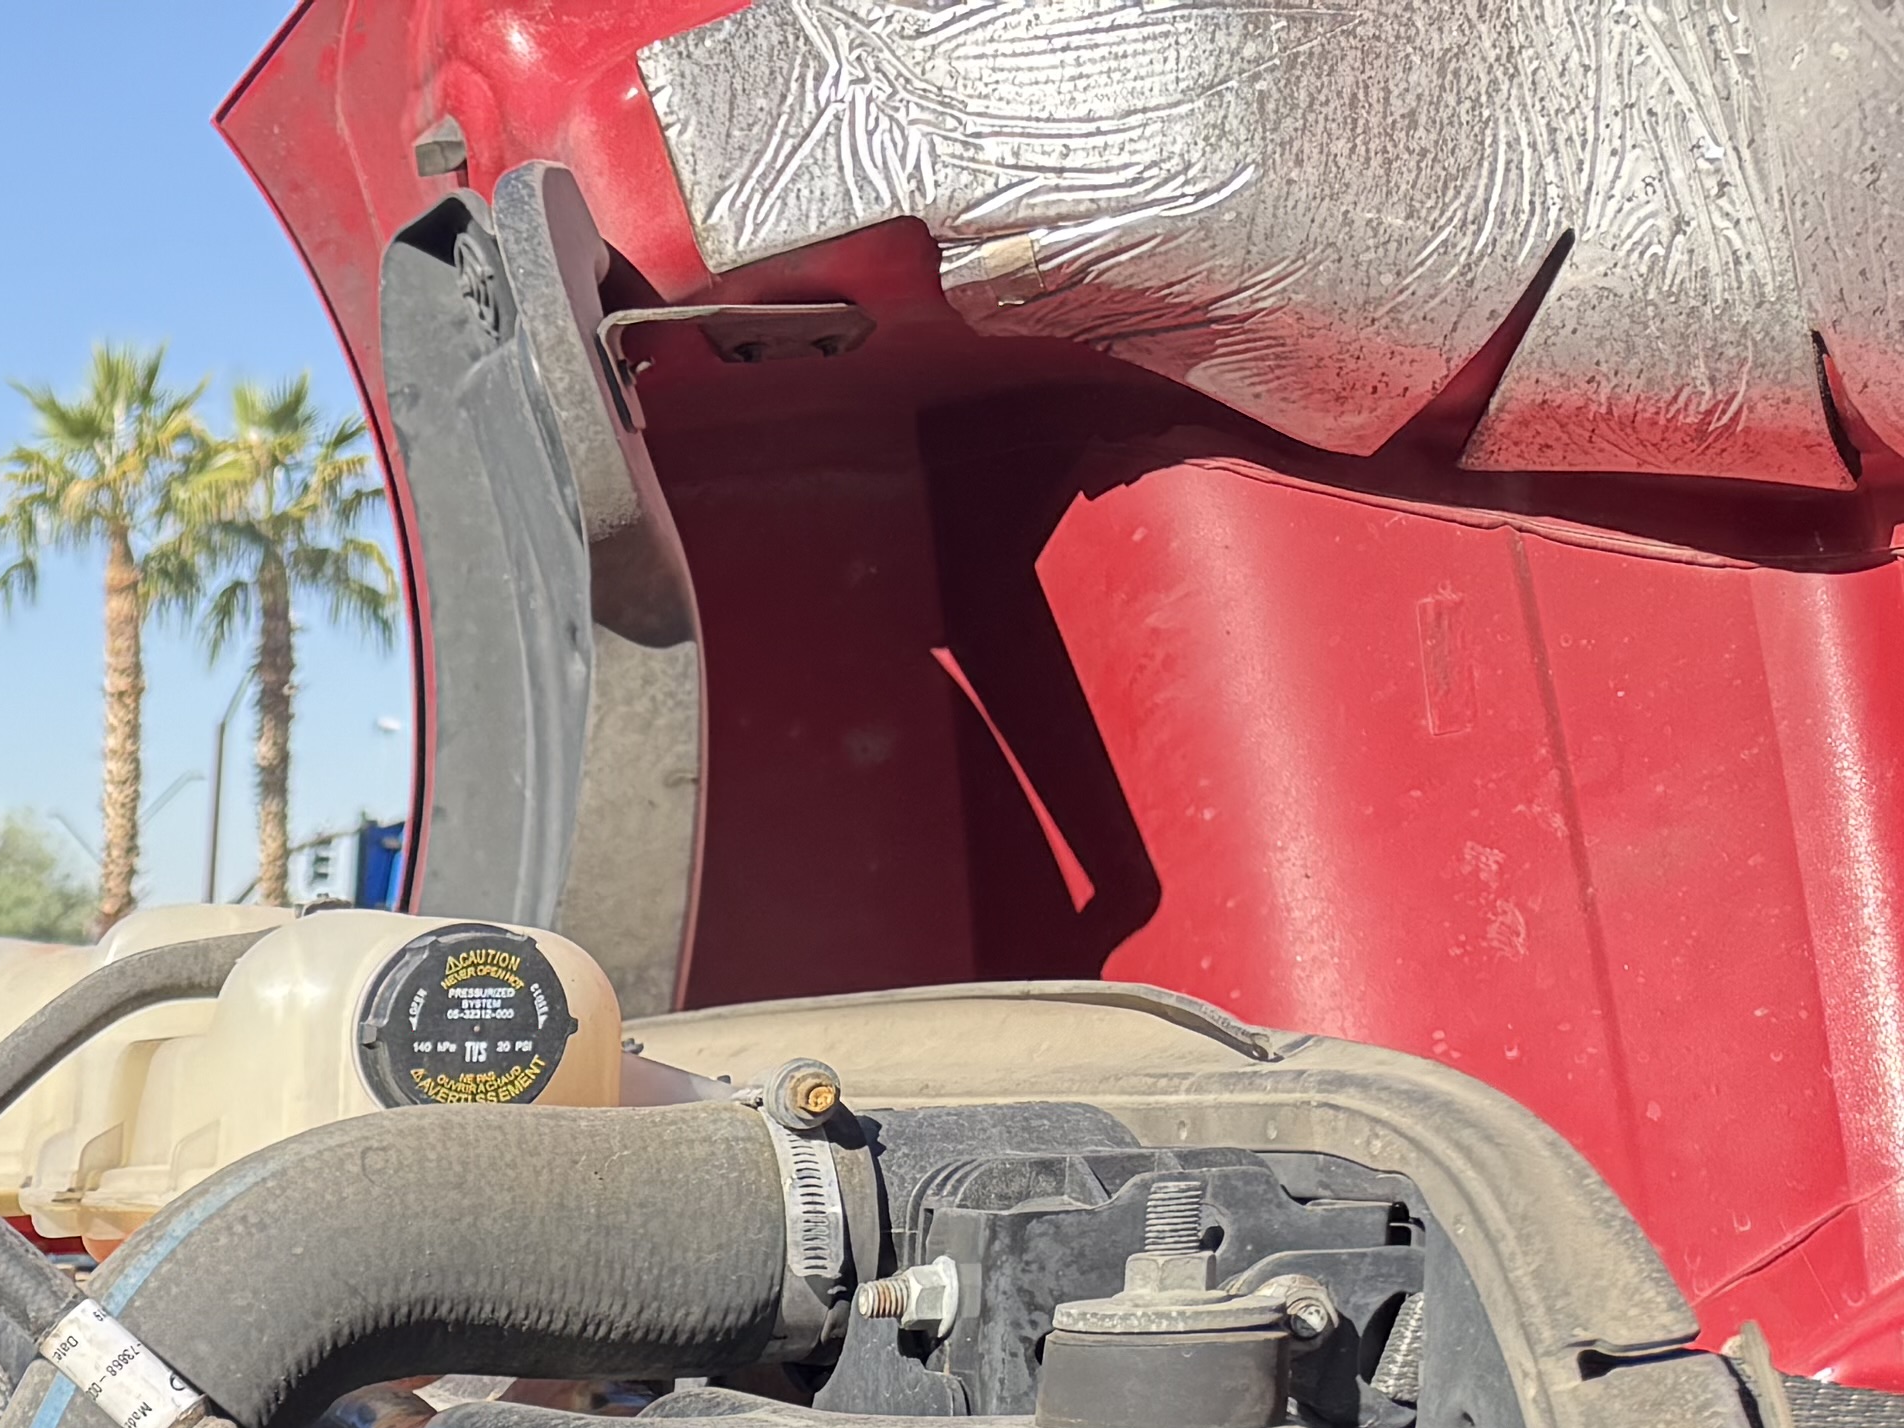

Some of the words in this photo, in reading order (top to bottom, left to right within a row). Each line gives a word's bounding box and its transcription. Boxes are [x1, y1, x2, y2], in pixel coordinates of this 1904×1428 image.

[459, 949, 520, 971] CAUTION
[441, 967, 476, 990] NEVER
[477, 965, 507, 980] OPEN
[505, 974, 525, 990] HOT
[448, 988, 516, 998] PRESSURIZED
[461, 999, 501, 1008] SYSTEM
[413, 1041, 432, 1053] 140
[465, 1041, 487, 1063] TVS
[496, 1041, 511, 1053] 20
[515, 1040, 533, 1053] PSI
[416, 1054, 546, 1103] AVERTISSEMENT
[437, 1074, 477, 1093] OUVRIR
[486, 1065, 522, 1090] CHAUD
[460, 1073, 475, 1083] NE
[476, 1071, 496, 1084] PAS
